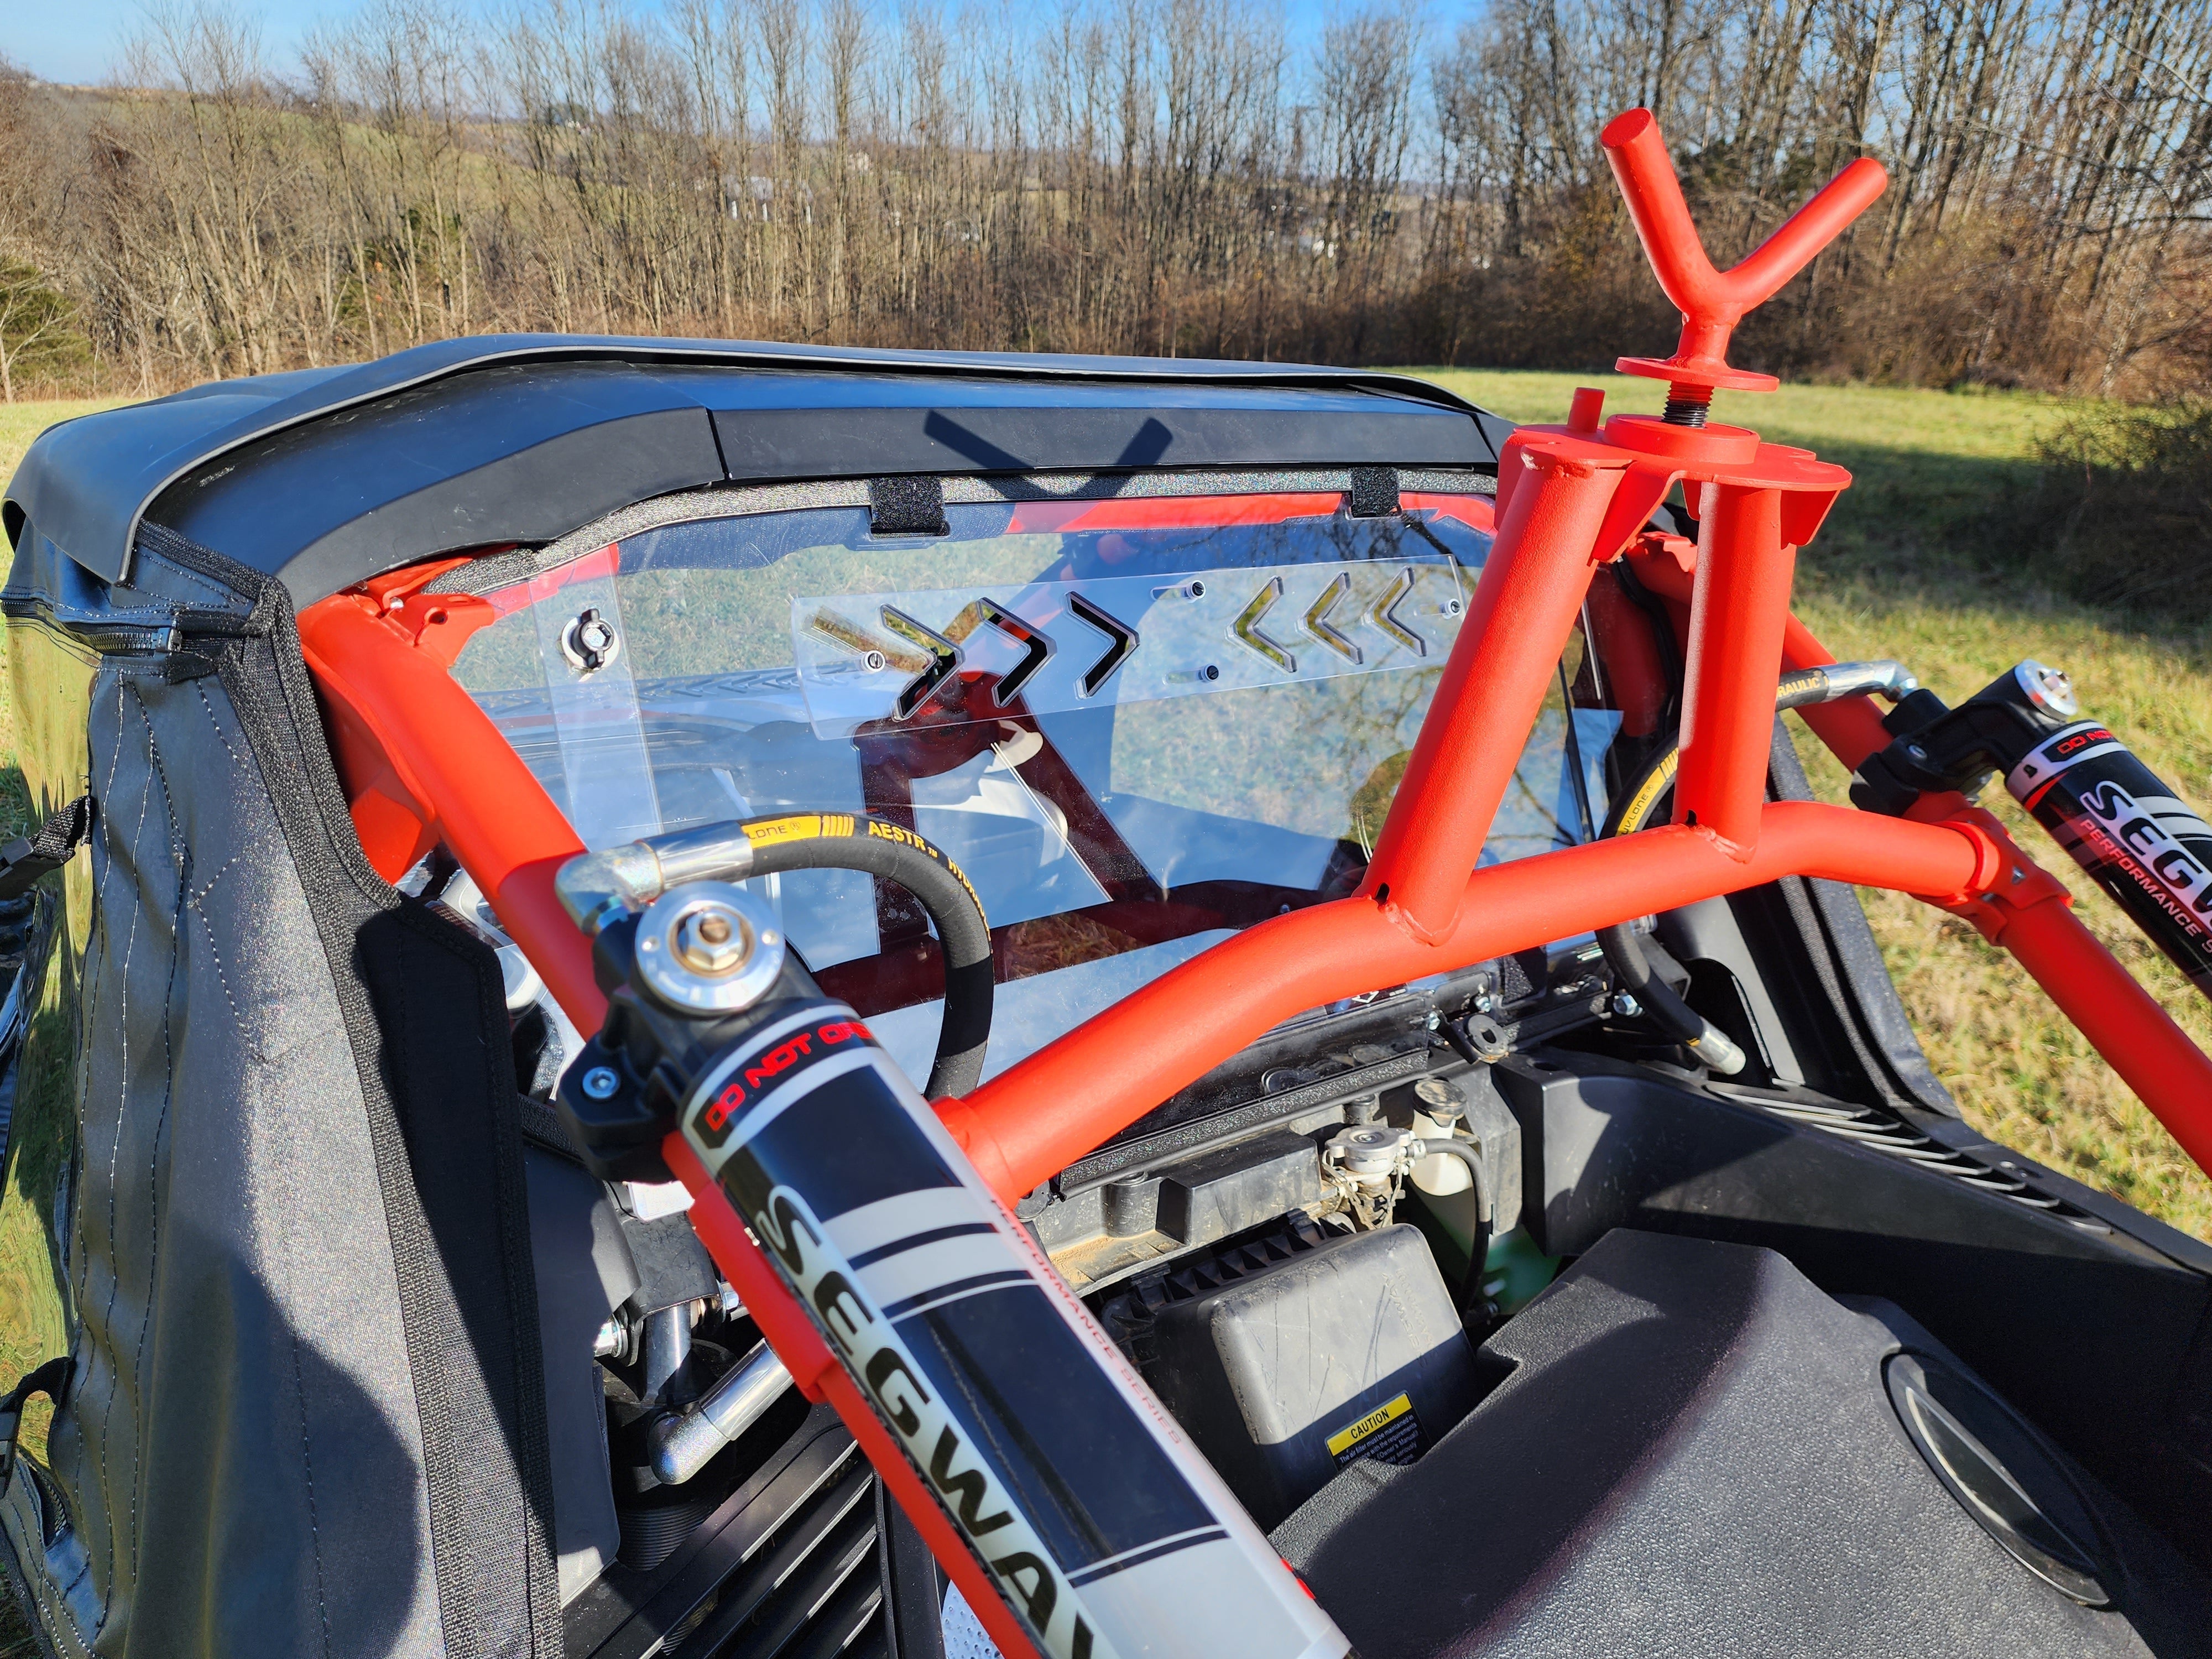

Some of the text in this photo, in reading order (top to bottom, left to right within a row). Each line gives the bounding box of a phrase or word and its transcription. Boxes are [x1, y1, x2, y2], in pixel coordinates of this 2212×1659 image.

[2057, 735, 2087, 754] DO
[868, 820, 926, 851] AESTR
[2080, 818, 2202, 937] PERFORMANCE
[705, 1083, 746, 1131] DO
[744, 1032, 812, 1089] NOT
[991, 1199, 1181, 1445] PERFORMANCE SERIES
[1339, 1454, 1350, 1463] The
[1355, 1443, 1366, 1454] filter
[1366, 1436, 1379, 1447] must
[1378, 1432, 1385, 1440] be
[1384, 1417, 1410, 1436] maintained
[1350, 1408, 1390, 1439] CAUTION
[1370, 1422, 1417, 1454] with the requirements
